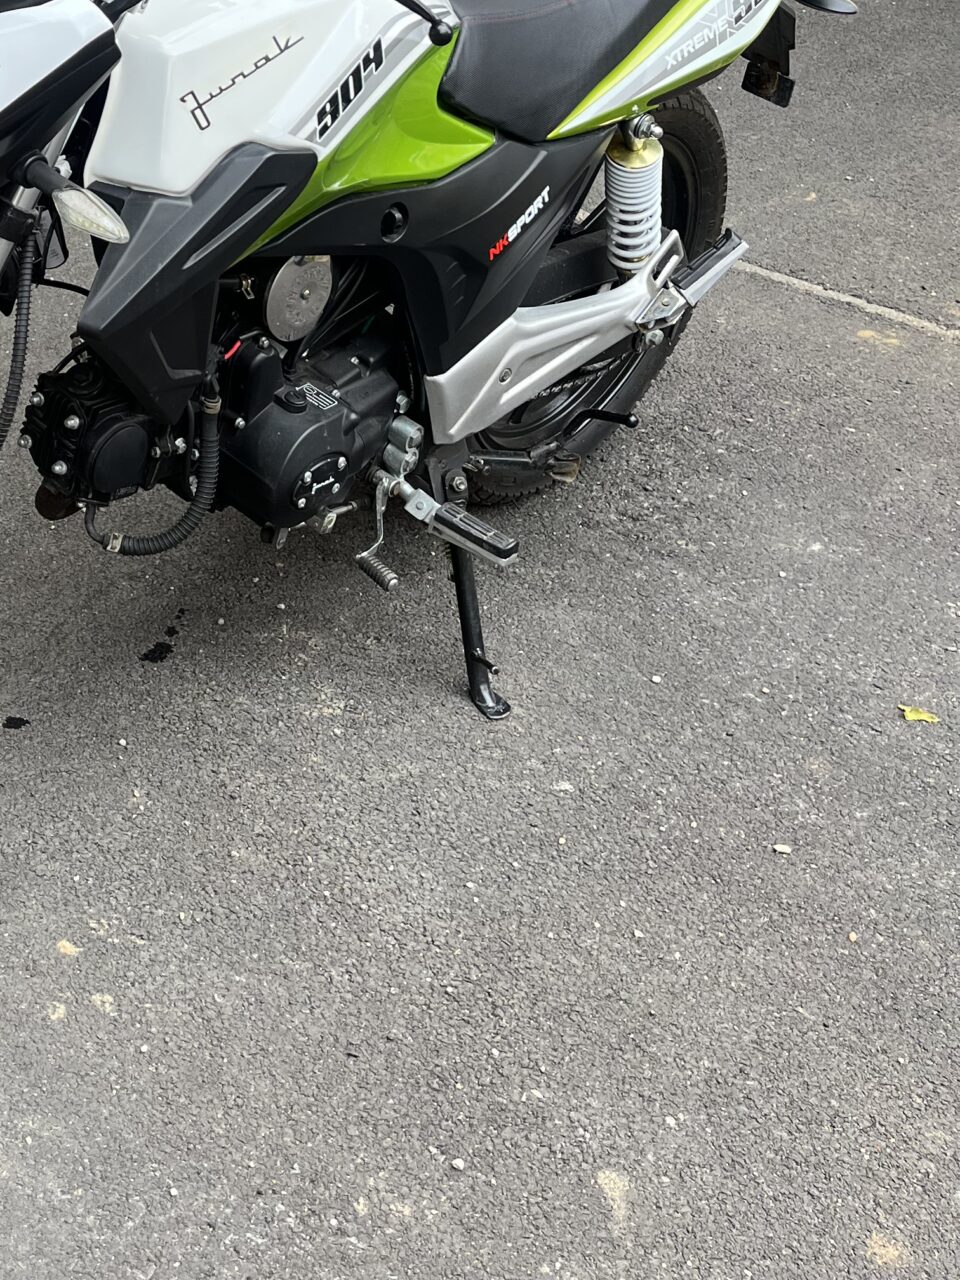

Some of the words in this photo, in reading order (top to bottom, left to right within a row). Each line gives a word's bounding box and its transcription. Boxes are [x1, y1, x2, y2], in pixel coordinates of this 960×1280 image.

[179, 35, 305, 131] Junak
[316, 35, 385, 142] 904
[664, 17, 729, 70] XTREME
